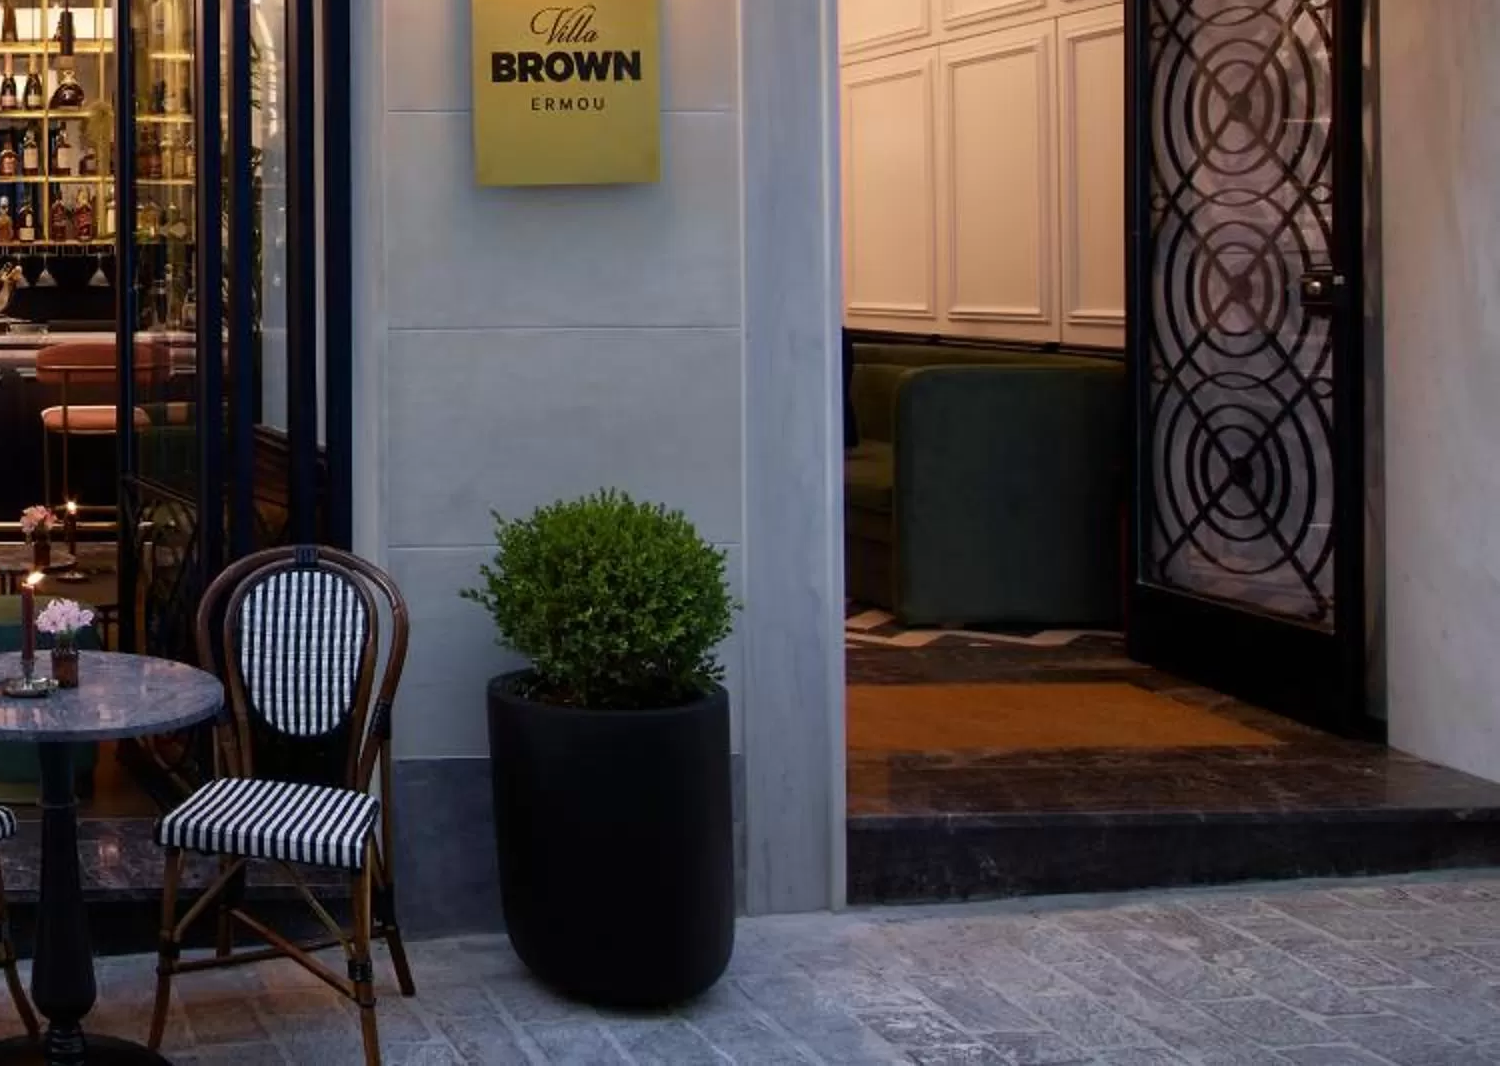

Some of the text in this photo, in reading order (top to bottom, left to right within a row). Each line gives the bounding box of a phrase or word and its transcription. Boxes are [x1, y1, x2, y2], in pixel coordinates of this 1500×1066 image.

[530, 4, 599, 45] Villa
[491, 50, 642, 83] BROWN
[531, 97, 605, 111] ERMOU
